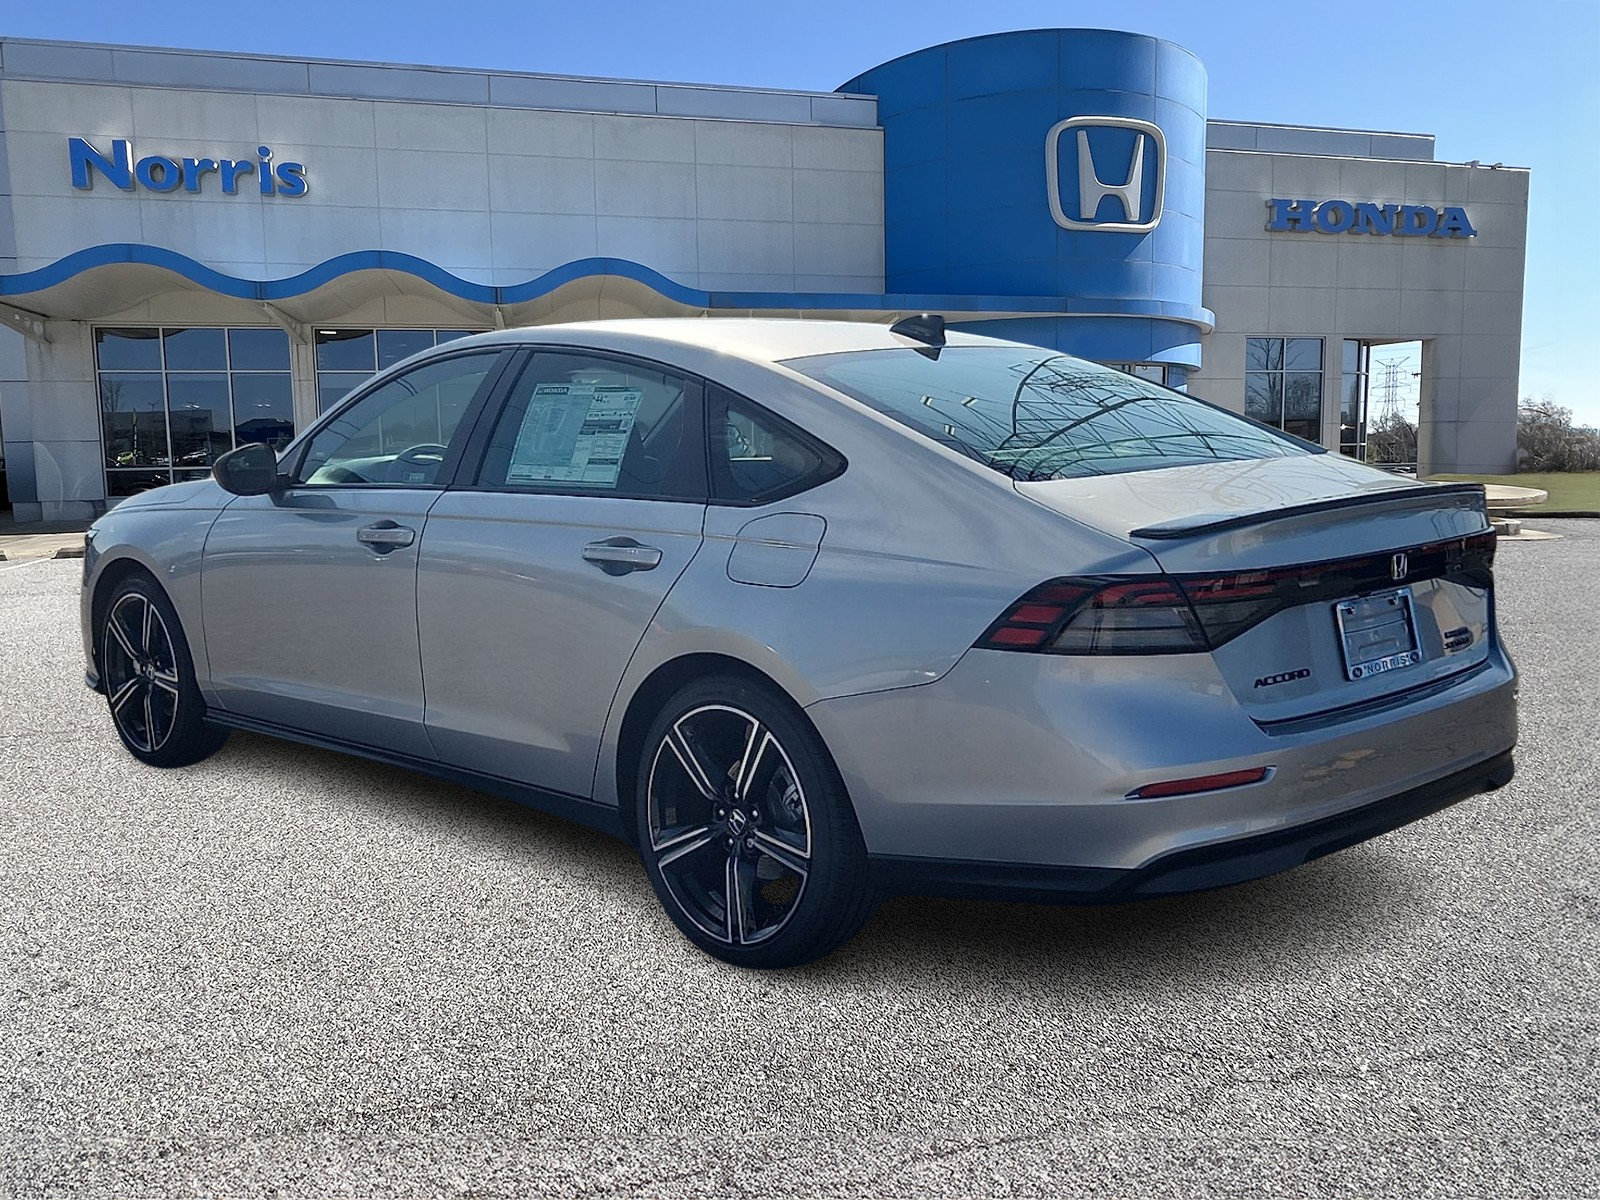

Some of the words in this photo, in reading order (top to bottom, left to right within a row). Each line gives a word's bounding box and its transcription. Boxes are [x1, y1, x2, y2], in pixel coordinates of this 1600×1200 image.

[68, 137, 308, 196] Norris
[1265, 198, 1477, 239] HONDA
[1253, 668, 1312, 689] ACCORD
[1365, 655, 1407, 674] NORRIS
